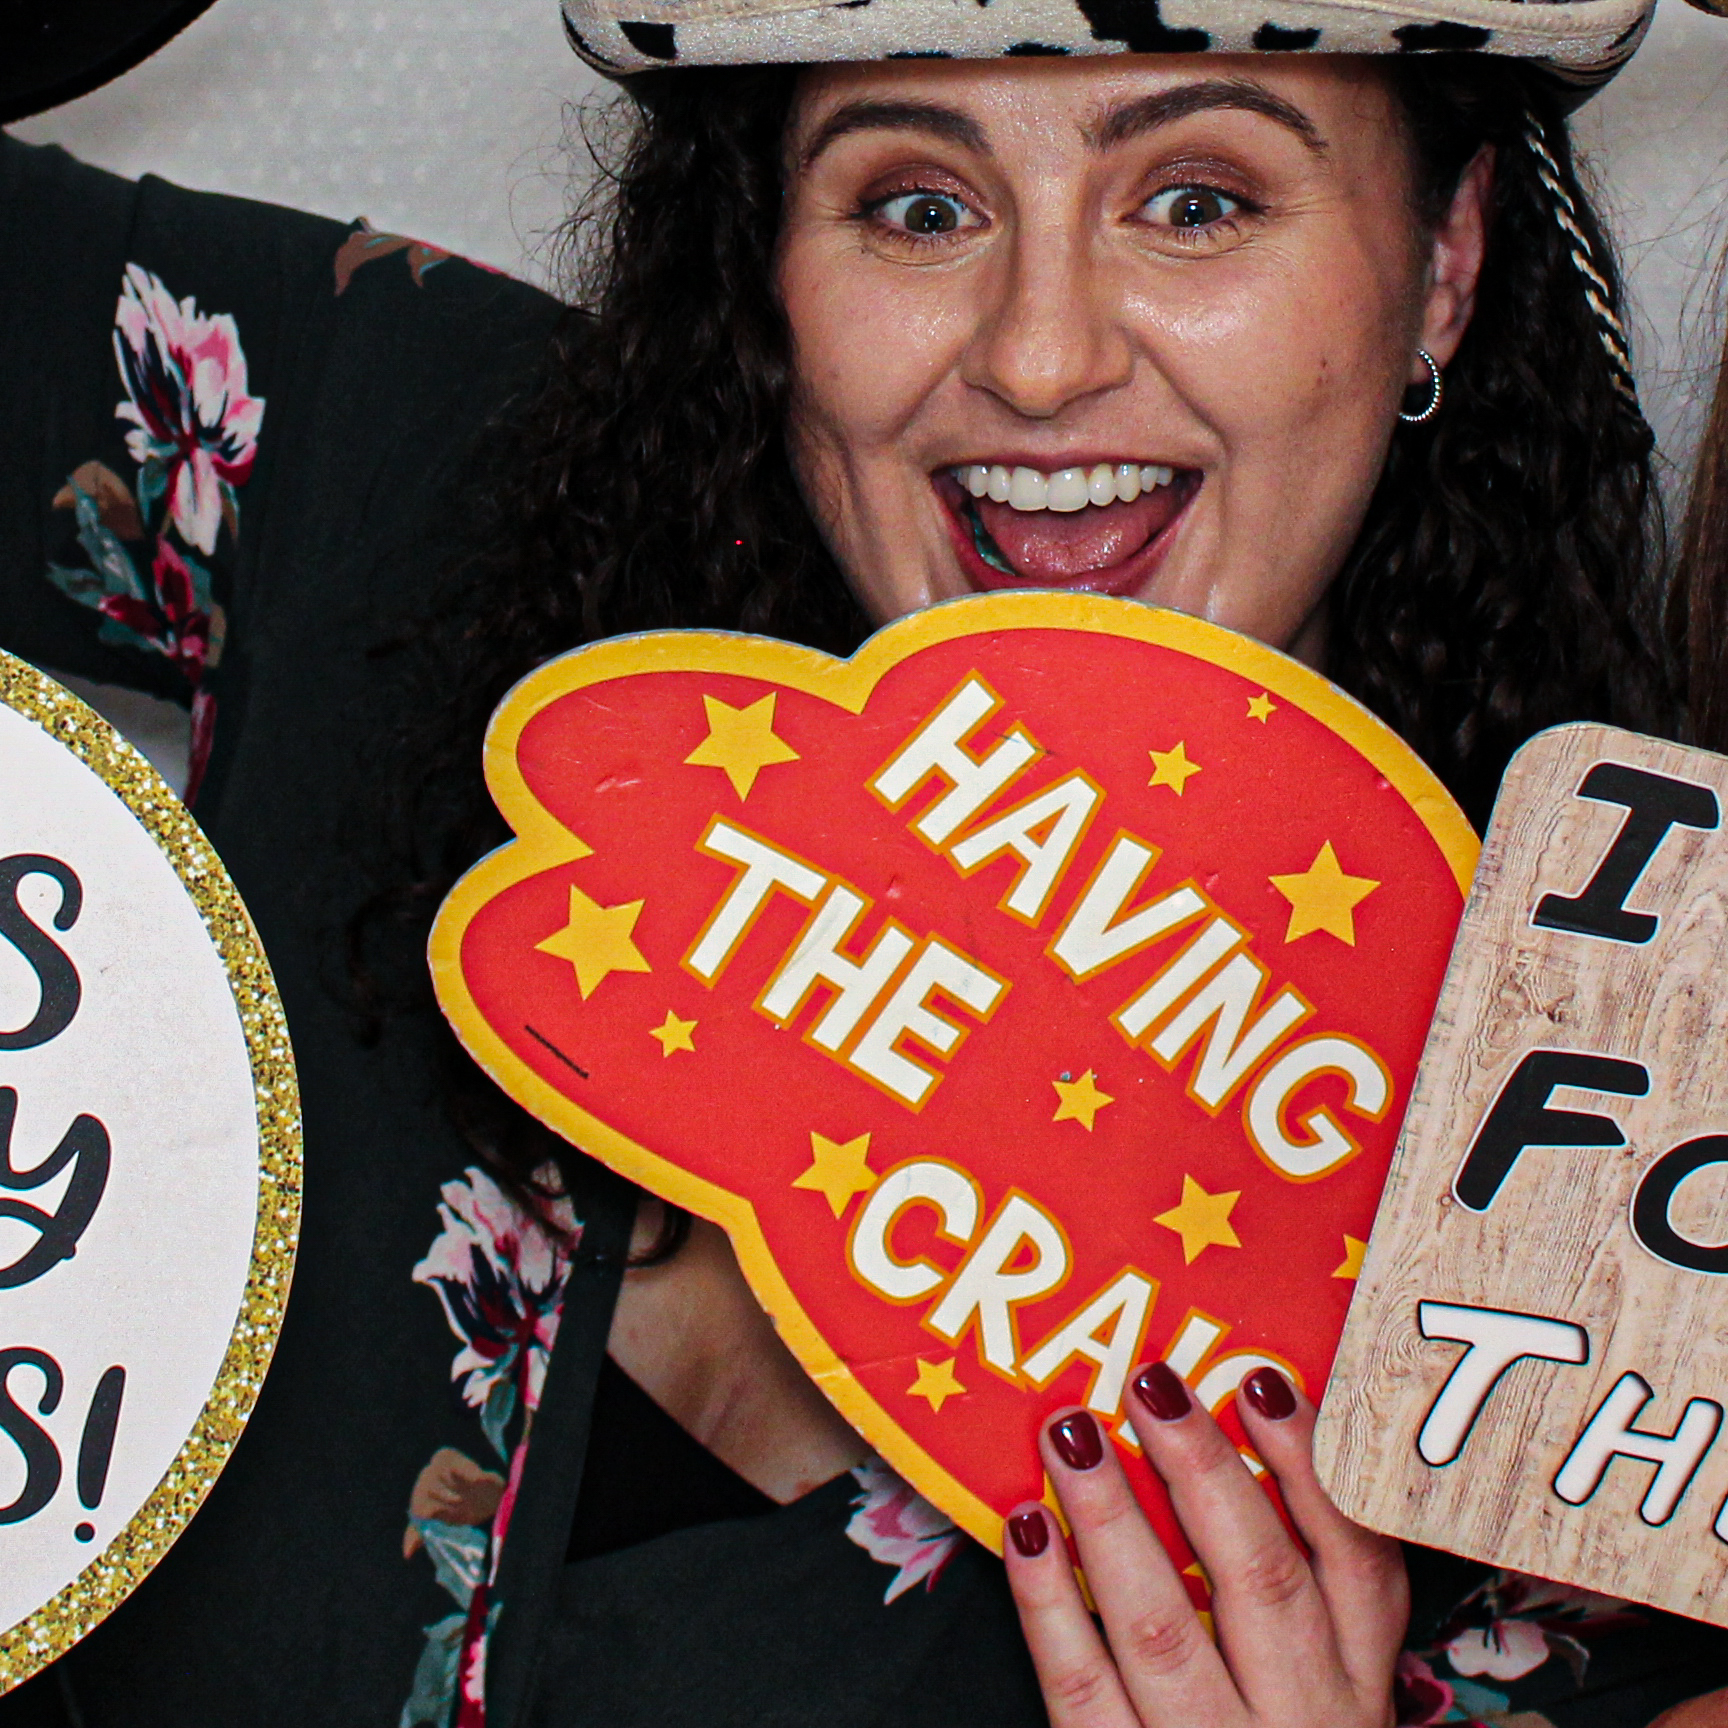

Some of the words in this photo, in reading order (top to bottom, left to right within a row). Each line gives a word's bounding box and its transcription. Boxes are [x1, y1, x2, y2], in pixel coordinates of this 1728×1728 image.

[682, 815, 1010, 1112] THE
[866, 671, 1393, 1180] HAVING
[1531, 760, 1723, 946] I
